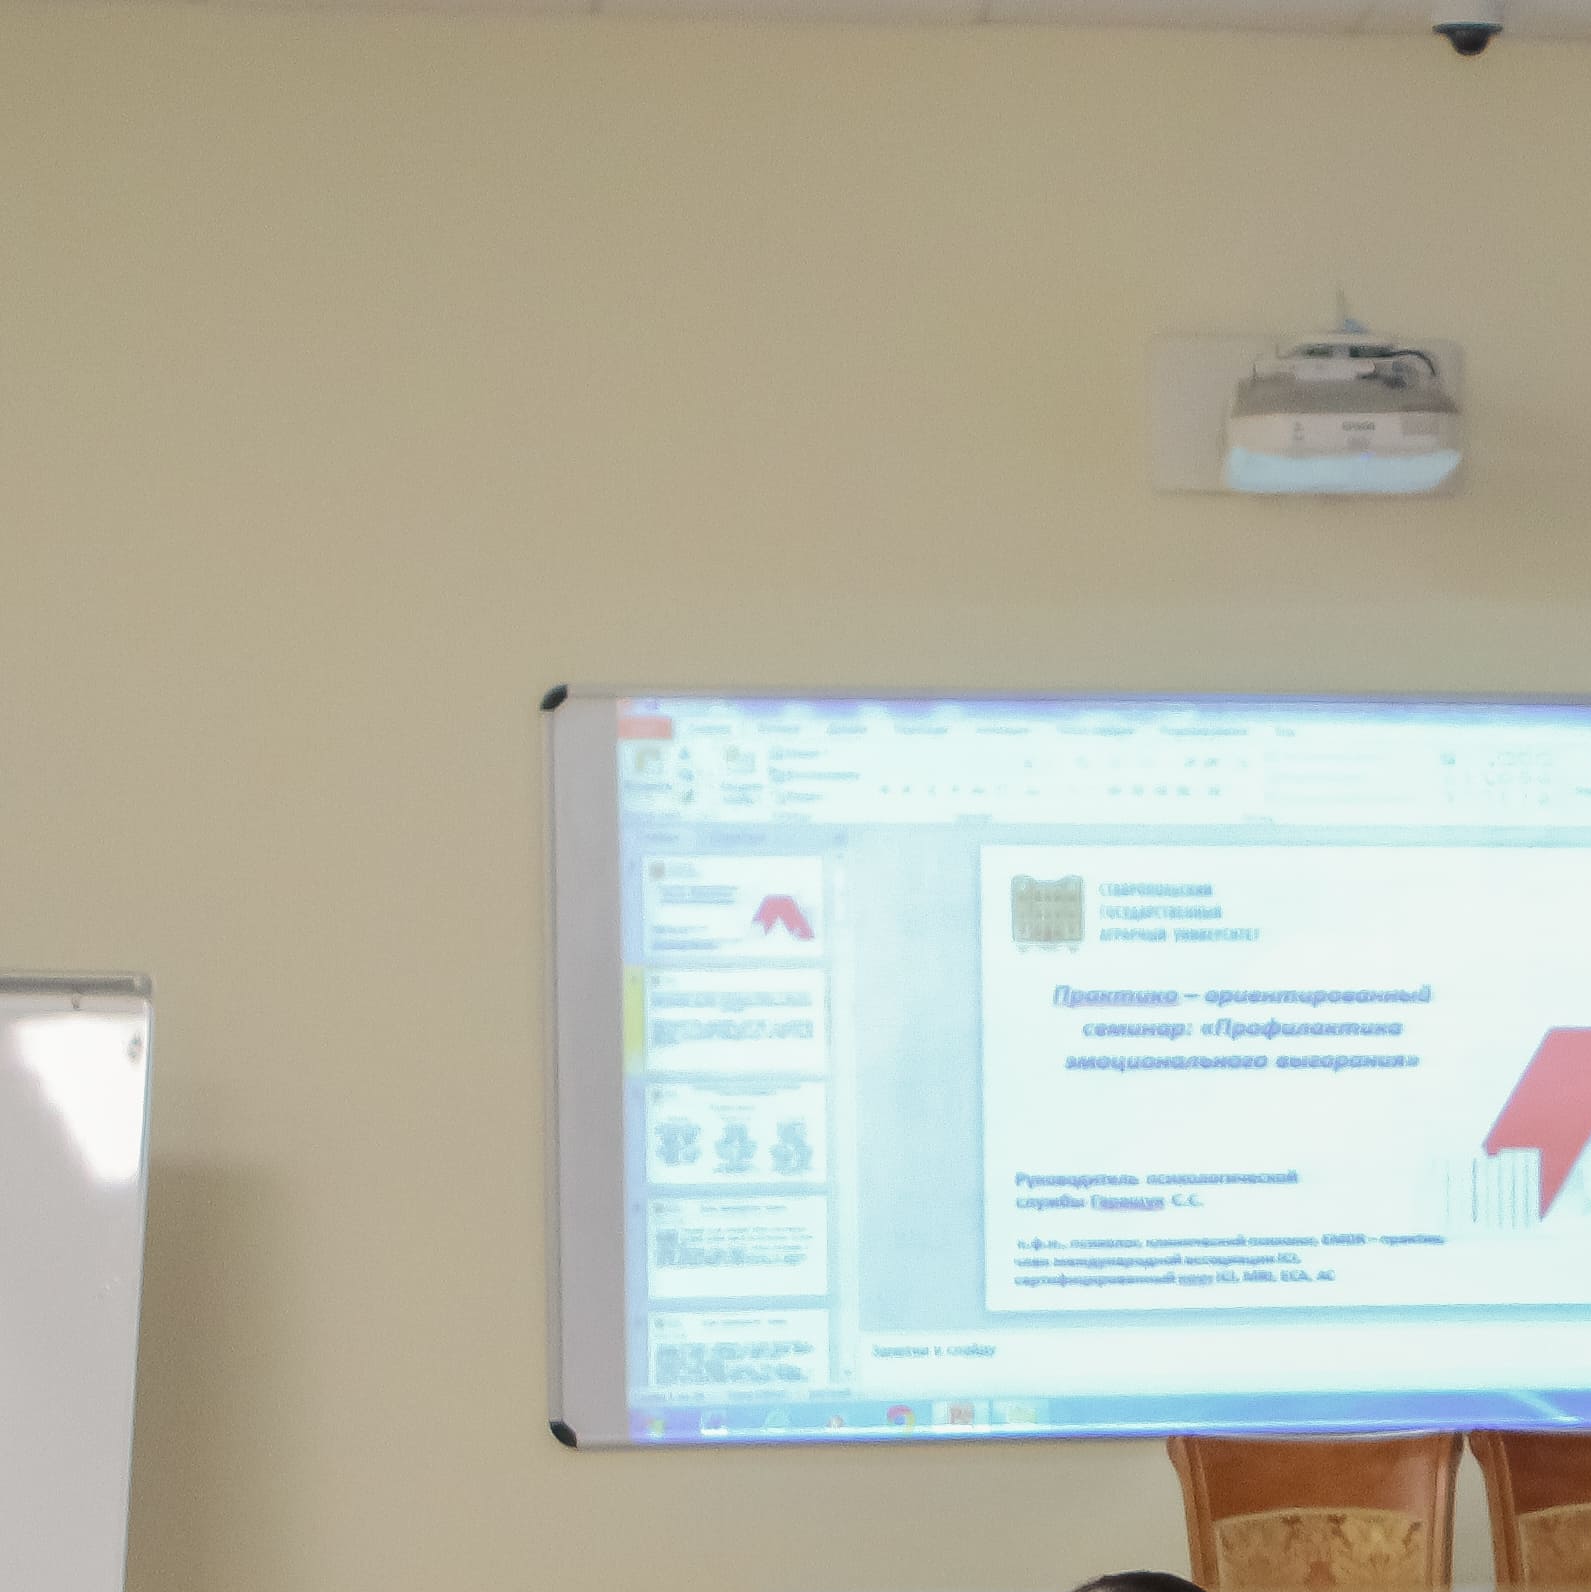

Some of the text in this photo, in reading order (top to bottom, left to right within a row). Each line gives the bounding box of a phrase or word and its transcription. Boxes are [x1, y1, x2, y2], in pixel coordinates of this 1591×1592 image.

[1053, 985, 1181, 1006] Практико
[1203, 985, 1432, 1008] ориентированный
[1082, 1018, 1403, 1041] семинар: «Профилактика
[1065, 1055, 1420, 1073] эмоционального выгорания»
